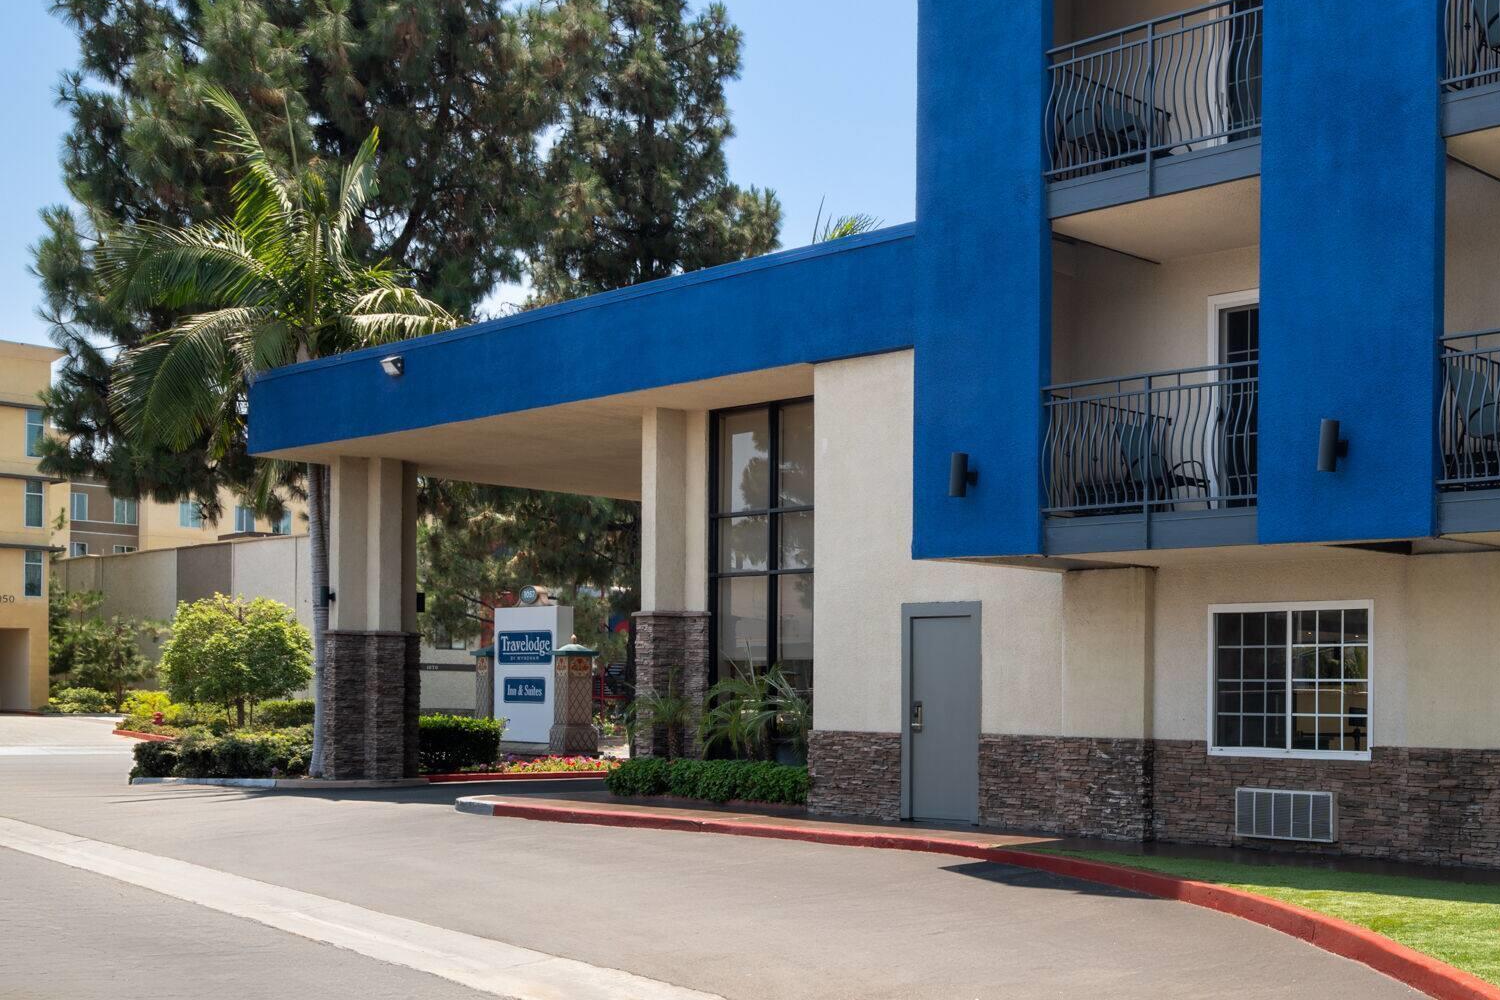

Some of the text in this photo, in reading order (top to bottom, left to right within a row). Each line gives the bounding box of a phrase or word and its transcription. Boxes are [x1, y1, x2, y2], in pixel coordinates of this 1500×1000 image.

[500, 635, 551, 656] Travelodge
[507, 684, 543, 697] Inn & Suites
